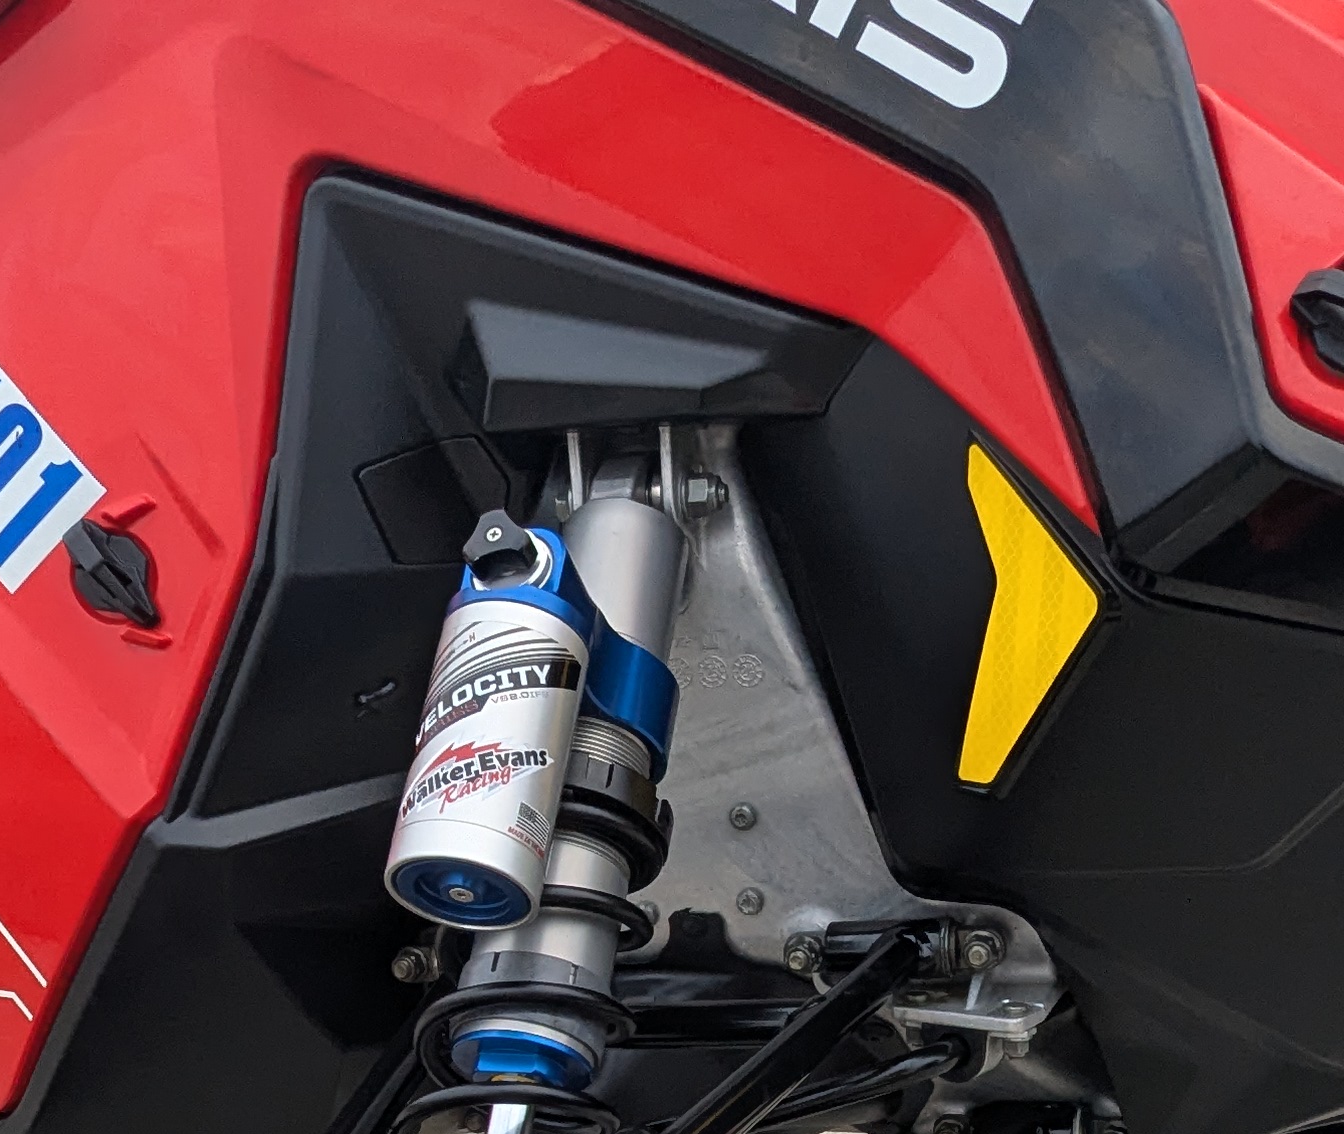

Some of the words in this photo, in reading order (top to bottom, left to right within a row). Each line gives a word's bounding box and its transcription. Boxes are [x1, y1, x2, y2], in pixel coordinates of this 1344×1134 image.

[415, 664, 551, 747] VELOCITY
[402, 760, 475, 818] Walker
[478, 750, 547, 773] Evans
[438, 766, 512, 814] Racing
